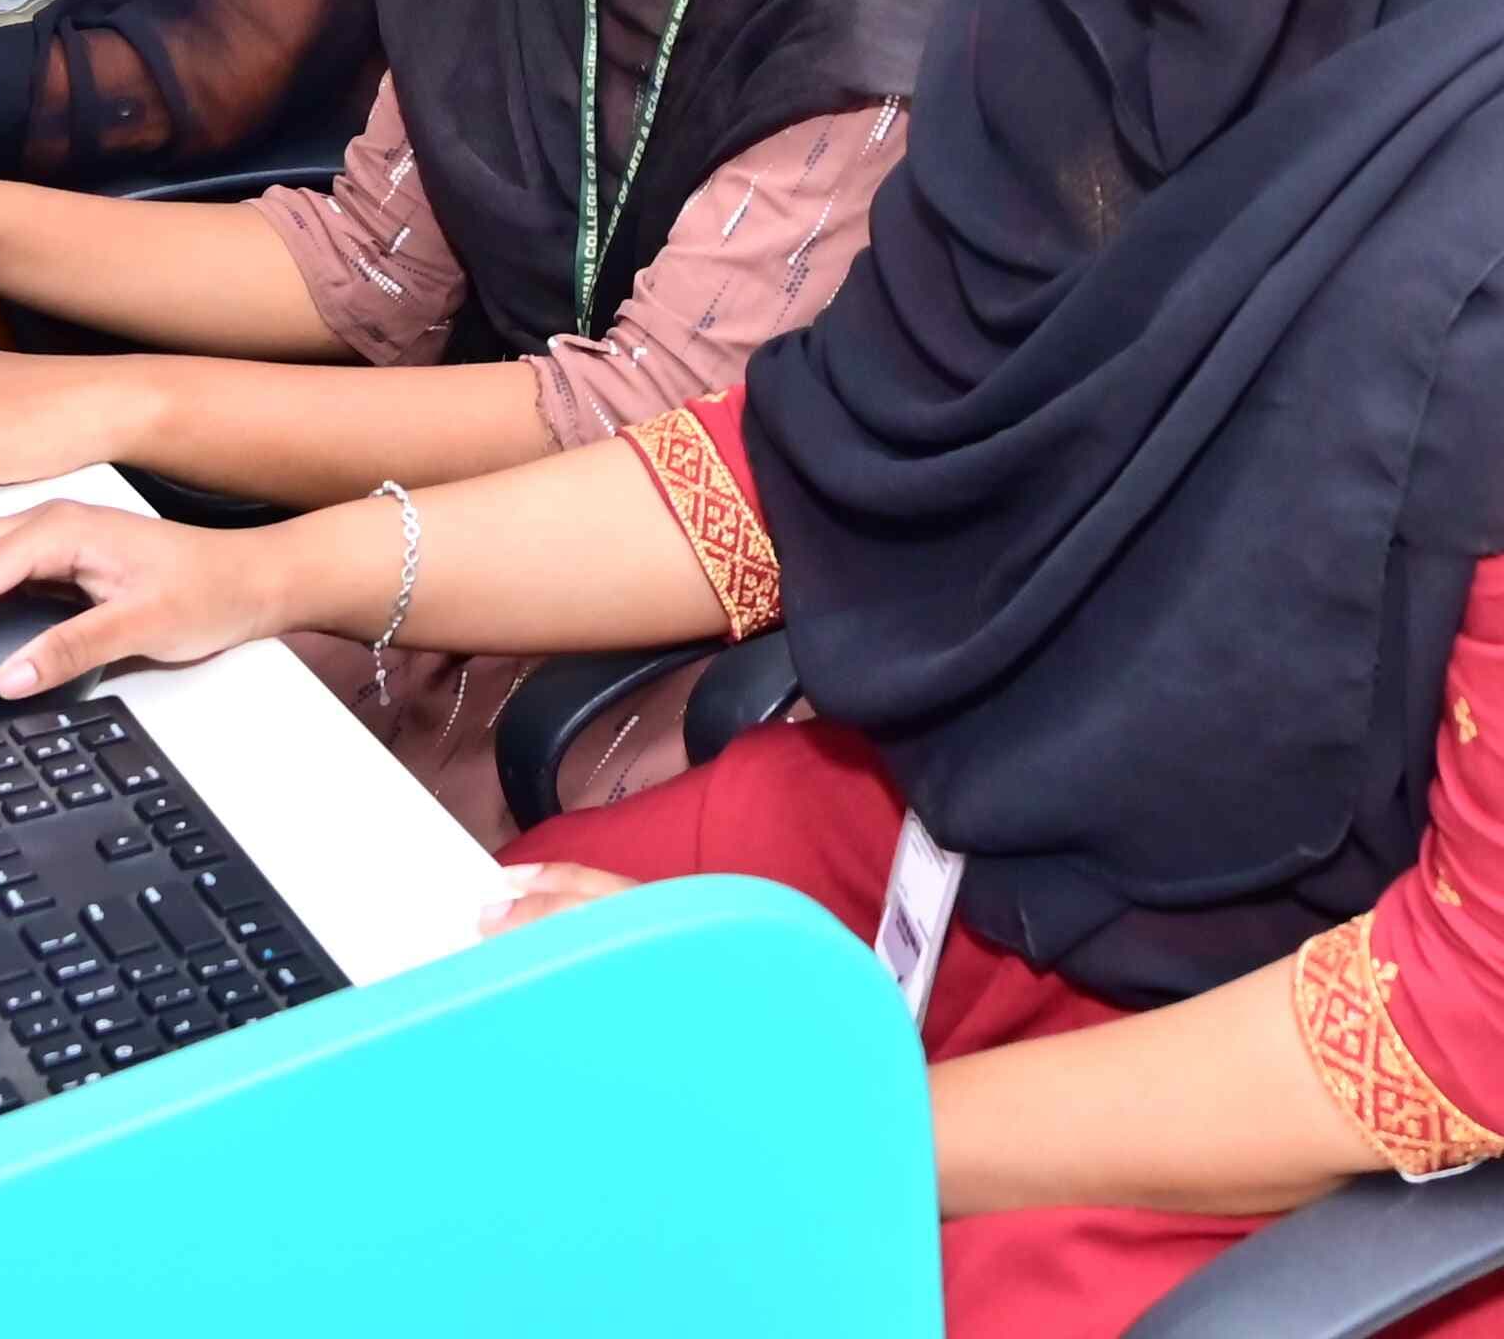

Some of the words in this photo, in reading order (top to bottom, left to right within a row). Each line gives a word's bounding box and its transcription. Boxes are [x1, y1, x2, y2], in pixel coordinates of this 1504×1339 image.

[586, 17, 597, 90] SCIENCE
[585, 111, 596, 154] ARTS
[618, 181, 630, 204] OF
[626, 139, 646, 182] ARTS
[662, 22, 680, 55] FOR
[587, 159, 596, 180] OF
[584, 183, 598, 259] COLLEGE
